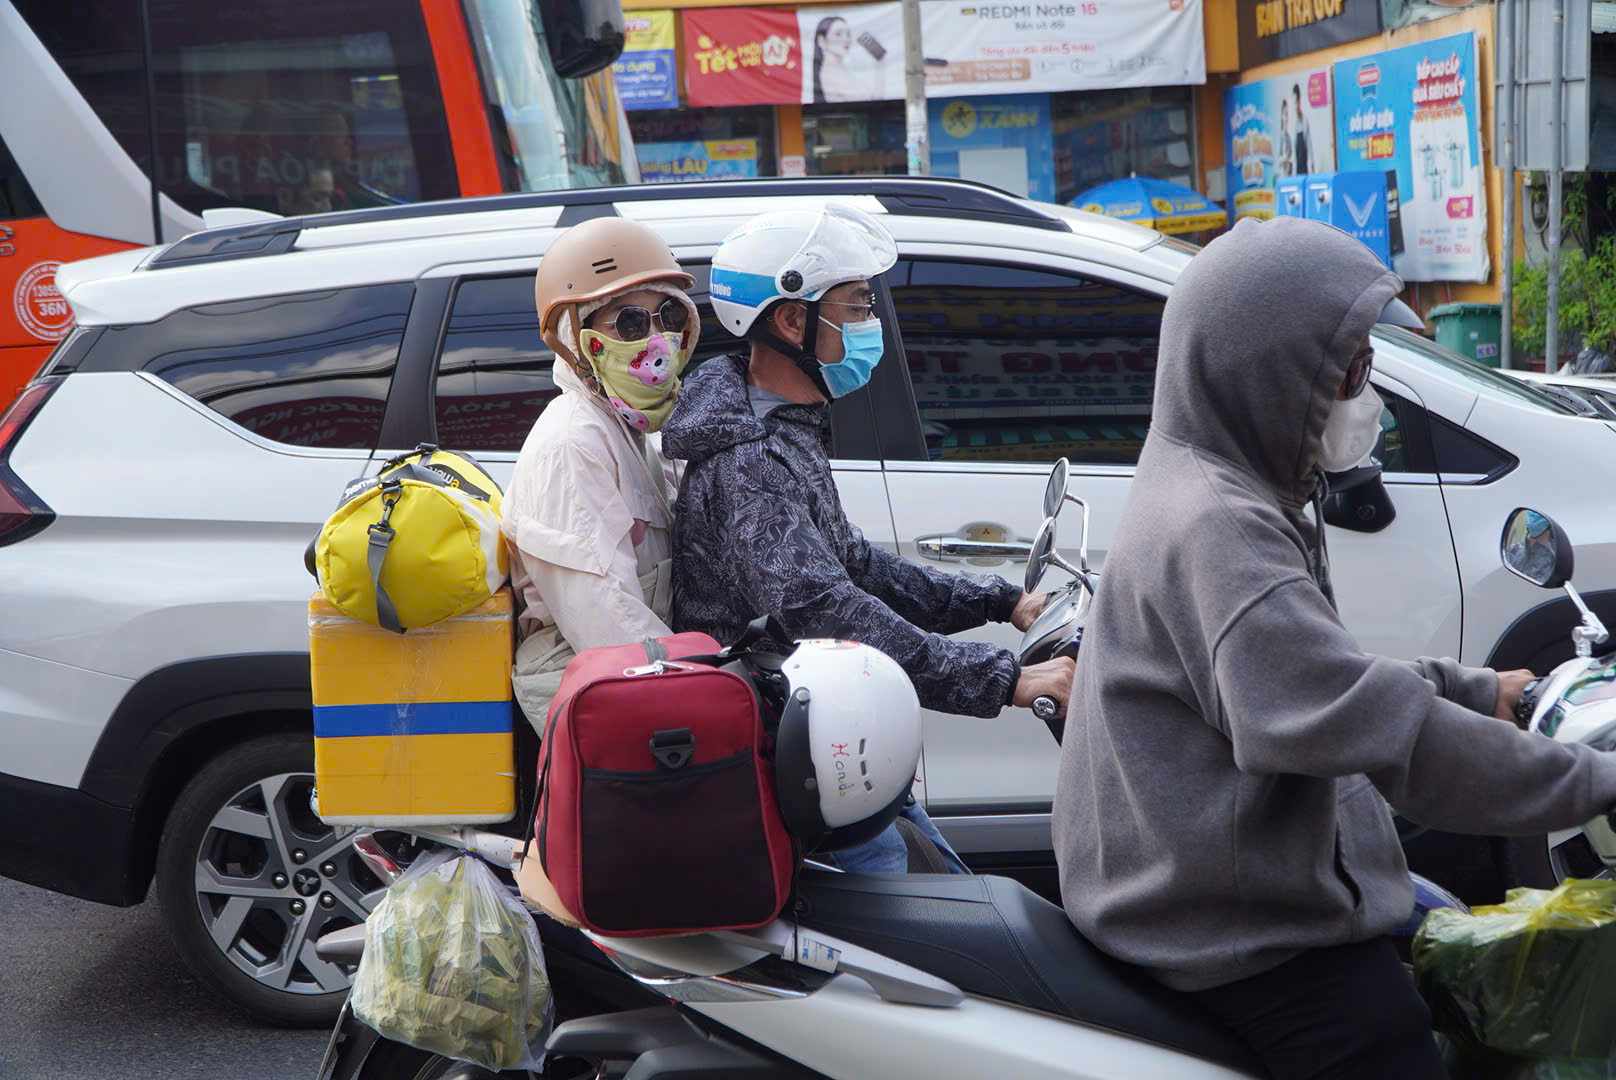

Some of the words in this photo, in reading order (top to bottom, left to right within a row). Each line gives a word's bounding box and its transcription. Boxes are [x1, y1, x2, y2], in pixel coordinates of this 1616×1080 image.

[980, 6, 1031, 19] REDMI
[1036, 5, 1076, 16] Note
[1061, 42, 1072, 55] 5
[694, 44, 737, 74] Tết
[39, 303, 67, 316] 36N
